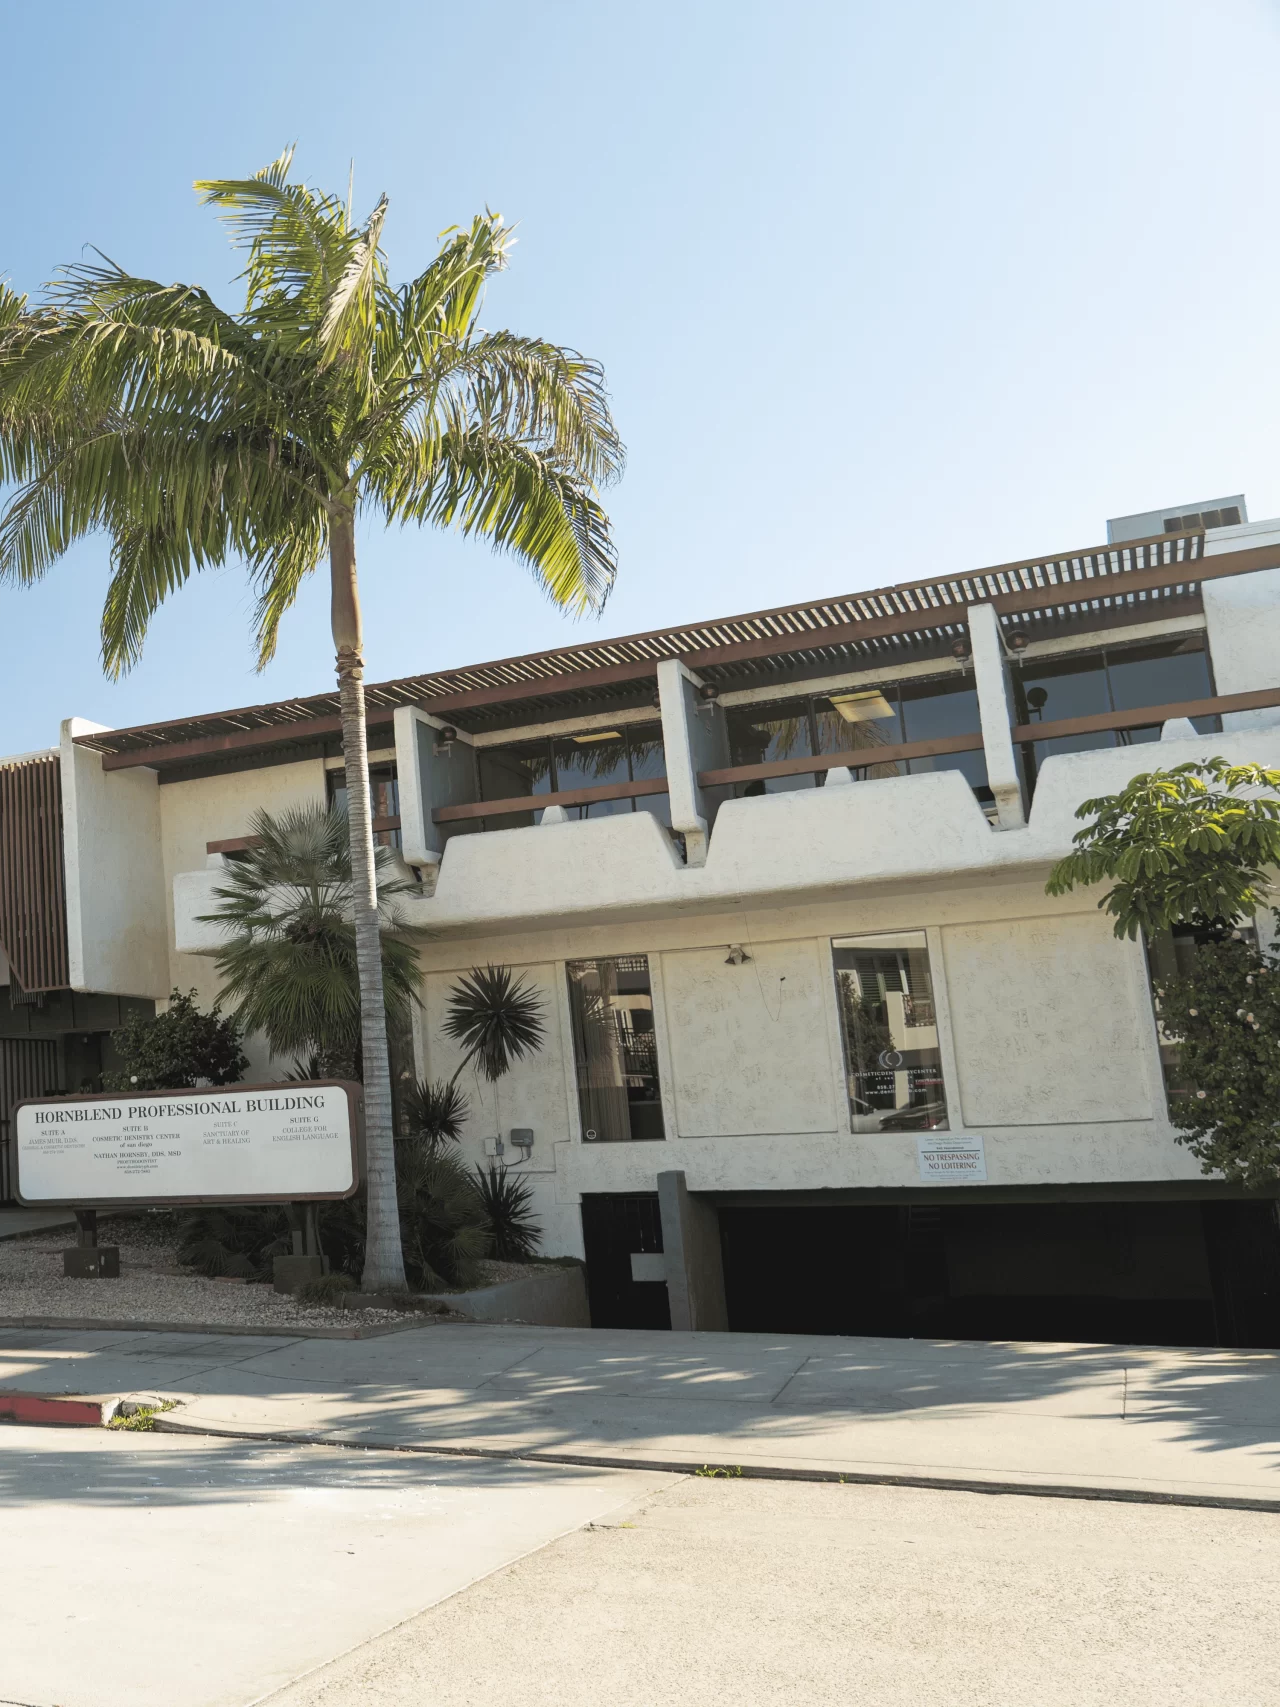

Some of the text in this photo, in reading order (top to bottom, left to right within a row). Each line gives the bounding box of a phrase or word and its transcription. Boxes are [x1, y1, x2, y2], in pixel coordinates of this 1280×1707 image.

[35, 1096, 325, 1124] HORNBLEND PROFESSIONAL BUILDING
